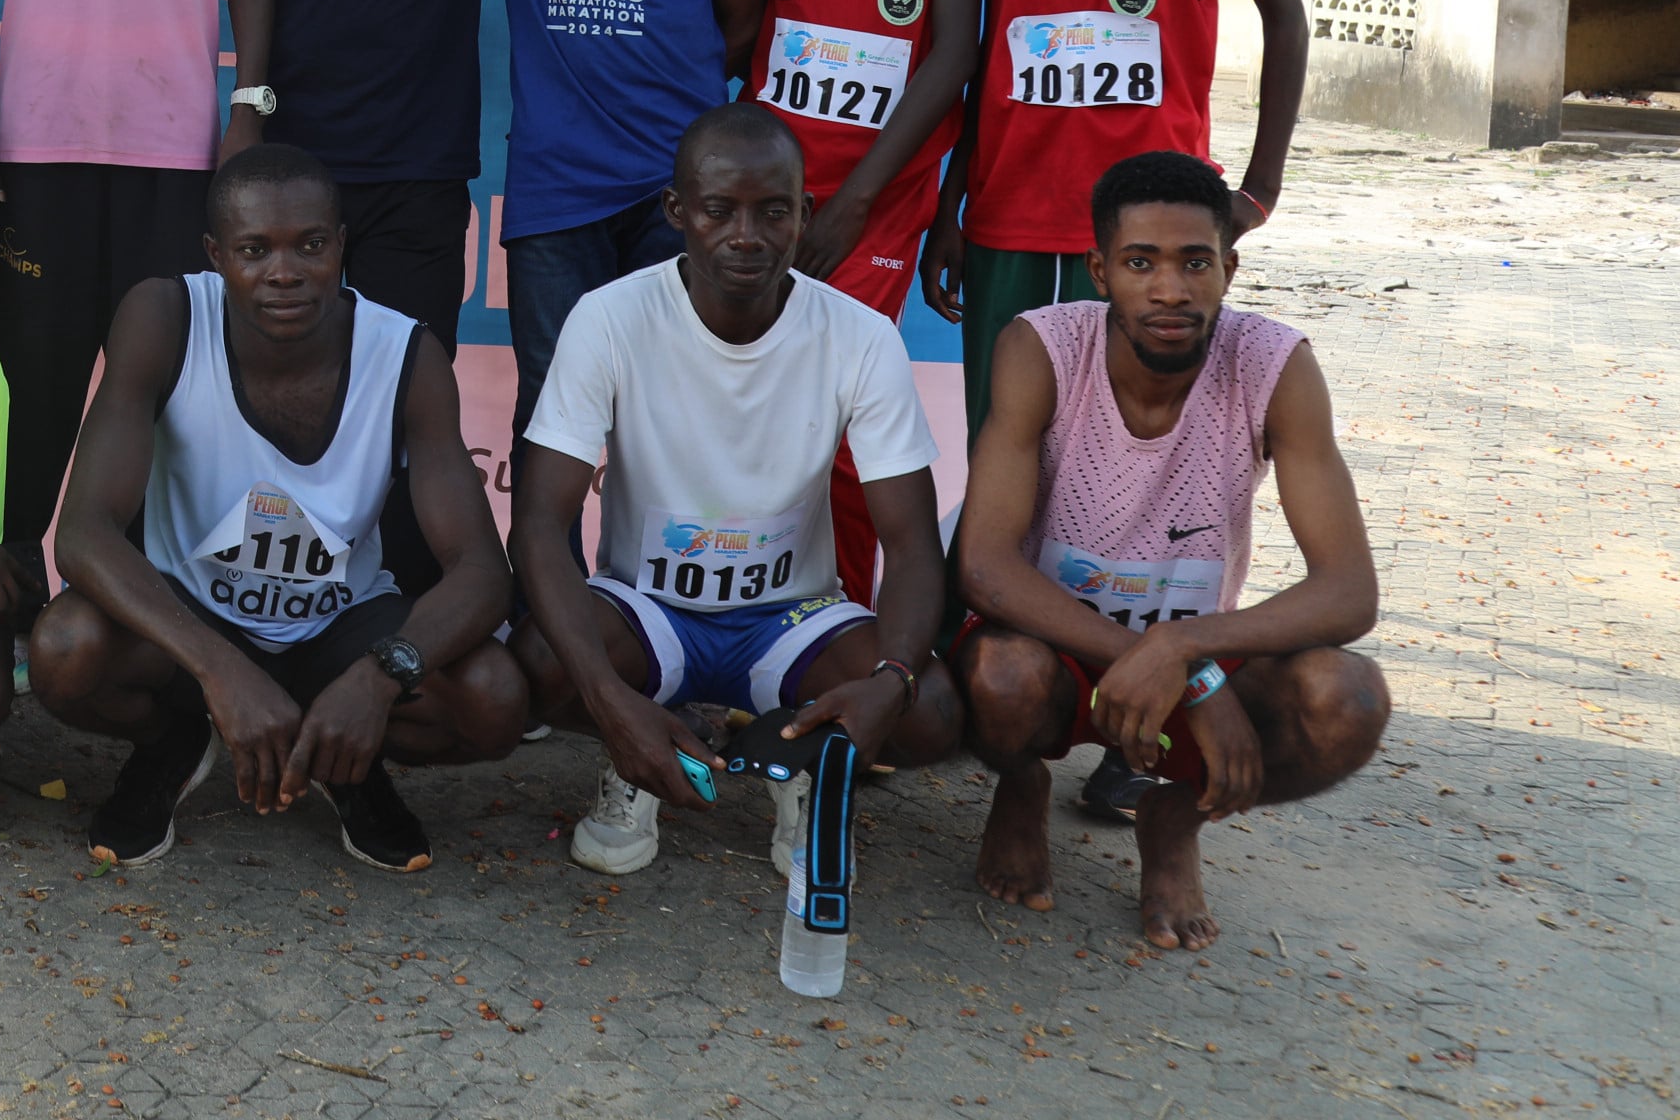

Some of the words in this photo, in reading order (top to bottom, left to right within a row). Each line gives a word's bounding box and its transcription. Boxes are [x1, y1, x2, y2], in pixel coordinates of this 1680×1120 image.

[548, 5, 645, 24] MARATHON
[568, 25, 613, 36] 2024
[1019, 62, 1154, 103] 10128
[771, 68, 892, 125] 10127
[871, 255, 904, 270] SPORT
[254, 495, 289, 515] PEACE
[715, 533, 750, 550] PEACE
[647, 550, 793, 601] 10130
[210, 578, 353, 619] adidas
